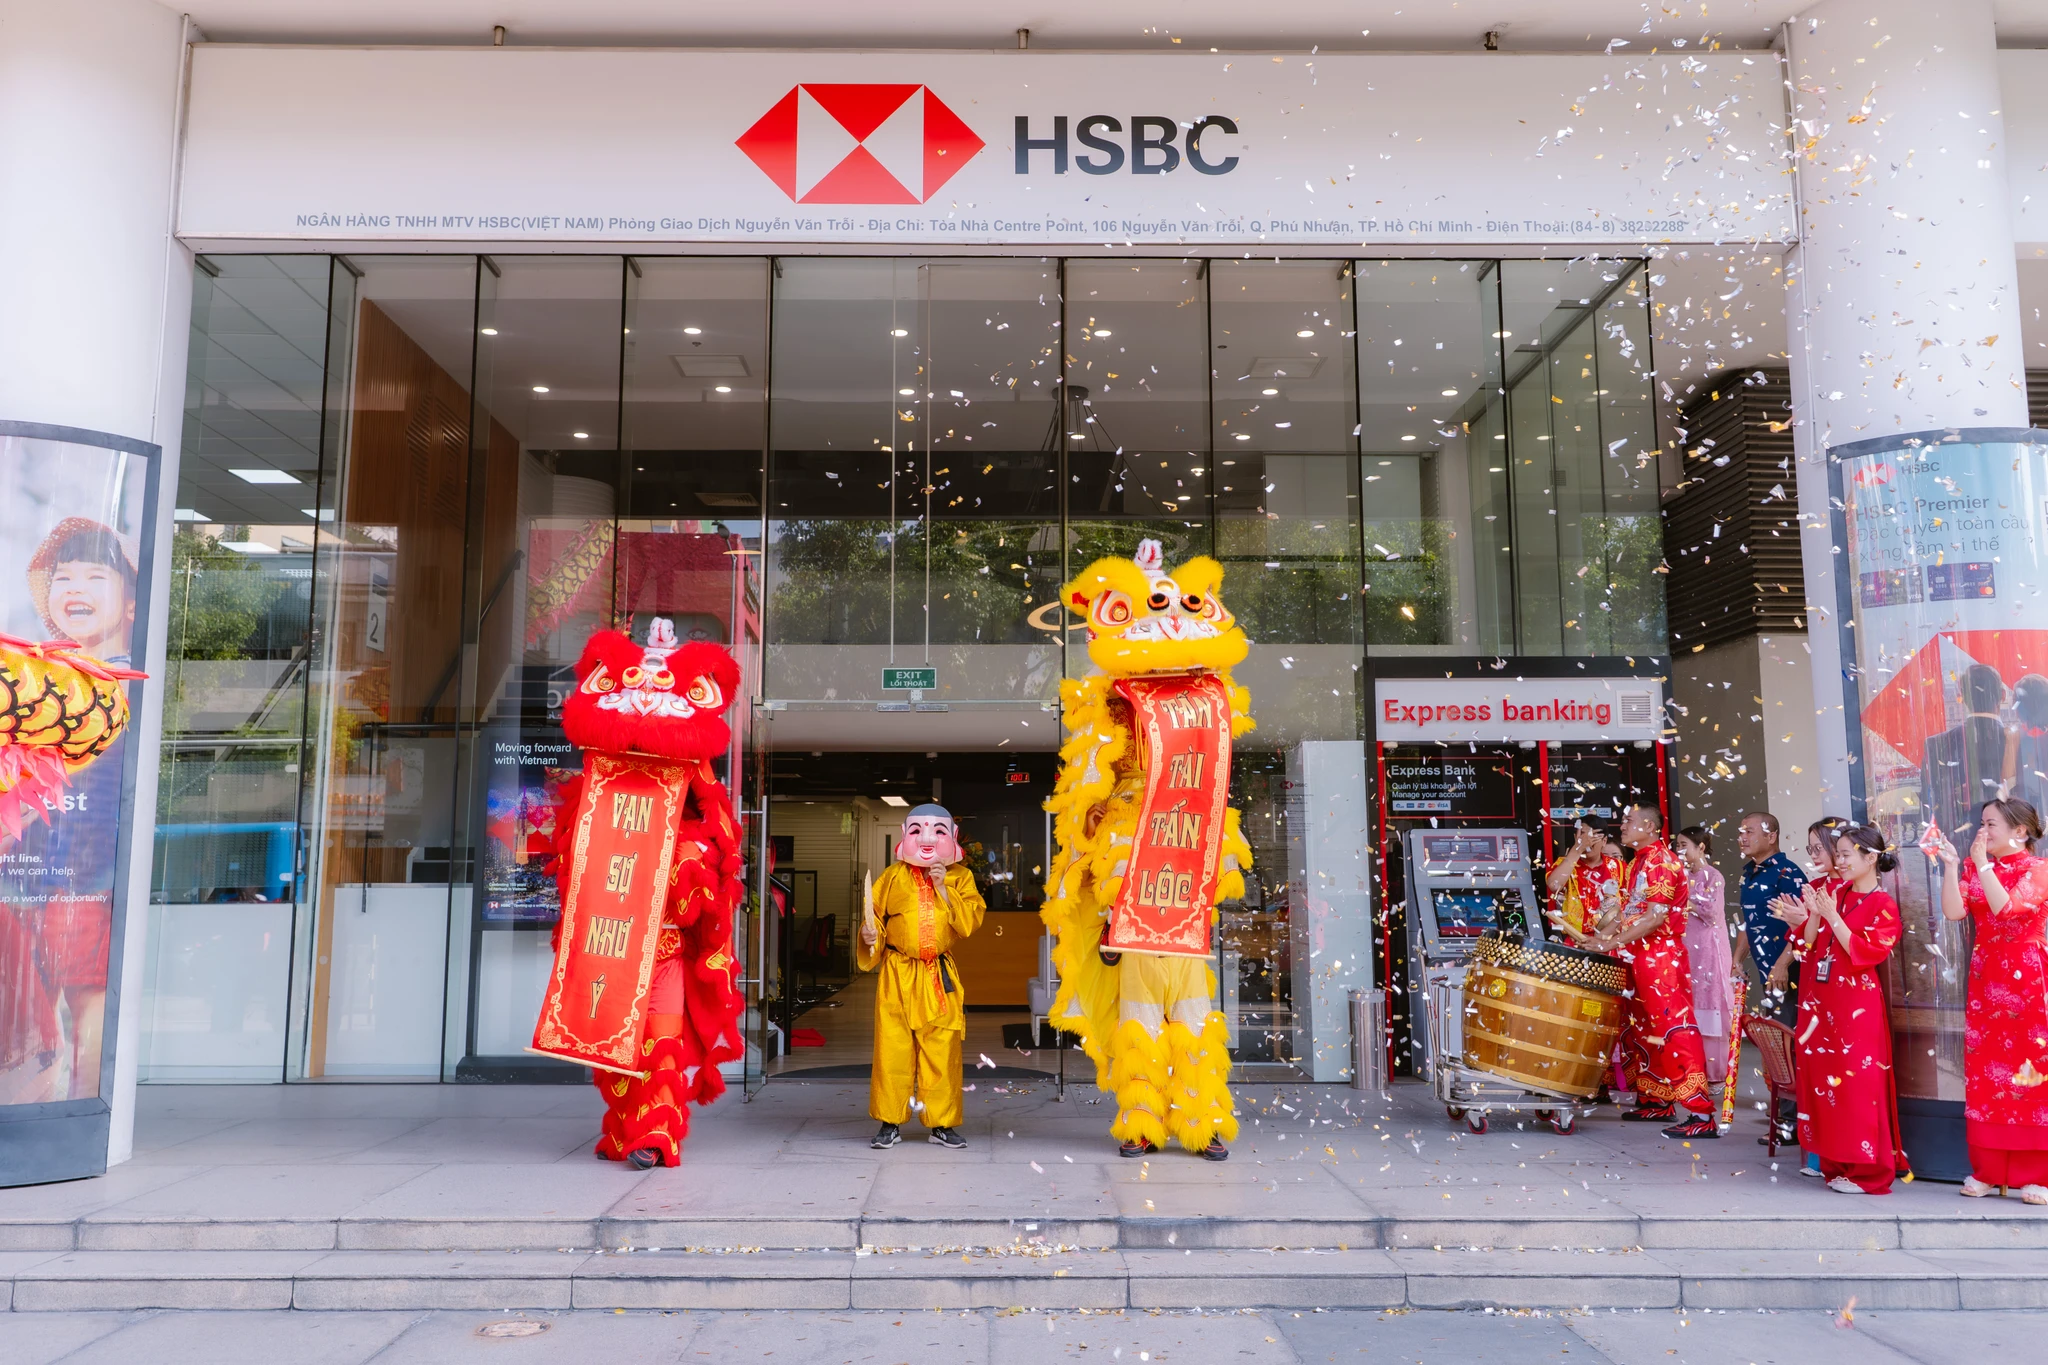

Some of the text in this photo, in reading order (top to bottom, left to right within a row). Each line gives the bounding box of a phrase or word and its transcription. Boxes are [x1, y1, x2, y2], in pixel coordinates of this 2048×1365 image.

[1014, 114, 1240, 176] HSBC
[296, 212, 341, 229] NGÂN
[345, 212, 391, 229] HÀNG
[395, 215, 437, 229] TNHH
[442, 215, 475, 229] MTV
[478, 214, 560, 232] HSBC(VIỆT
[564, 215, 604, 232] NAM)
[608, 216, 655, 233] Phòng
[660, 217, 694, 231] Giao
[698, 217, 731, 233] Dịch
[735, 215, 790, 234] Nguyễn
[796, 218, 823, 232] Văn
[827, 216, 855, 231] Trỗi
[868, 218, 892, 234] Địa
[895, 217, 925, 232] Chỉ:
[929, 218, 957, 232] Tòa
[960, 218, 989, 232] Nhà
[993, 218, 1041, 232] Centre
[1046, 219, 1088, 235] Point,
[1092, 219, 1118, 233] 106
[1122, 216, 1177, 236] Nguyễn
[1181, 218, 1210, 233] Văn
[1249, 219, 1266, 234] Q.
[1270, 218, 1299, 233] Phú
[1303, 219, 1354, 236] Nhuận,
[1358, 220, 1379, 233] TP.
[1384, 217, 1404, 233] Hồ
[1408, 218, 1434, 233] Chí
[1438, 219, 1473, 233] Minh
[1486, 218, 1520, 235] Điện
[1901, 461, 1940, 475] HSBC
[1855, 496, 1990, 521] HSBC Premier
[1958, 516, 1995, 531] toàn
[2001, 513, 2029, 530] cầu
[1859, 546, 1902, 562] xứng
[1973, 535, 2000, 551] thế
[369, 613, 379, 643] 2
[896, 671, 922, 679] EXIT
[890, 679, 902, 687] LỐI
[1384, 699, 1612, 726] Express banking
[495, 743, 572, 754] Moving forward
[495, 756, 558, 765] with Vietnam
[1167, 745, 1206, 790] TÀI
[1391, 765, 1476, 778] Express Bank
[1548, 764, 1569, 773] ATM
[1391, 791, 1420, 799] Manage
[1421, 792, 1438, 800] your
[1150, 799, 1202, 850] TẤN
[18, 853, 43, 863] line.
[8, 868, 25, 876] we
[27, 868, 48, 876] can
[51, 866, 76, 877] help.
[1136, 863, 1194, 916] LỘC
[21, 894, 47, 903] world
[49, 894, 59, 903] of
[60, 893, 108, 904] opportunity
[584, 792, 653, 1019] VẠN SỰ NHƯ Ý
[995, 925, 1004, 937] 3
